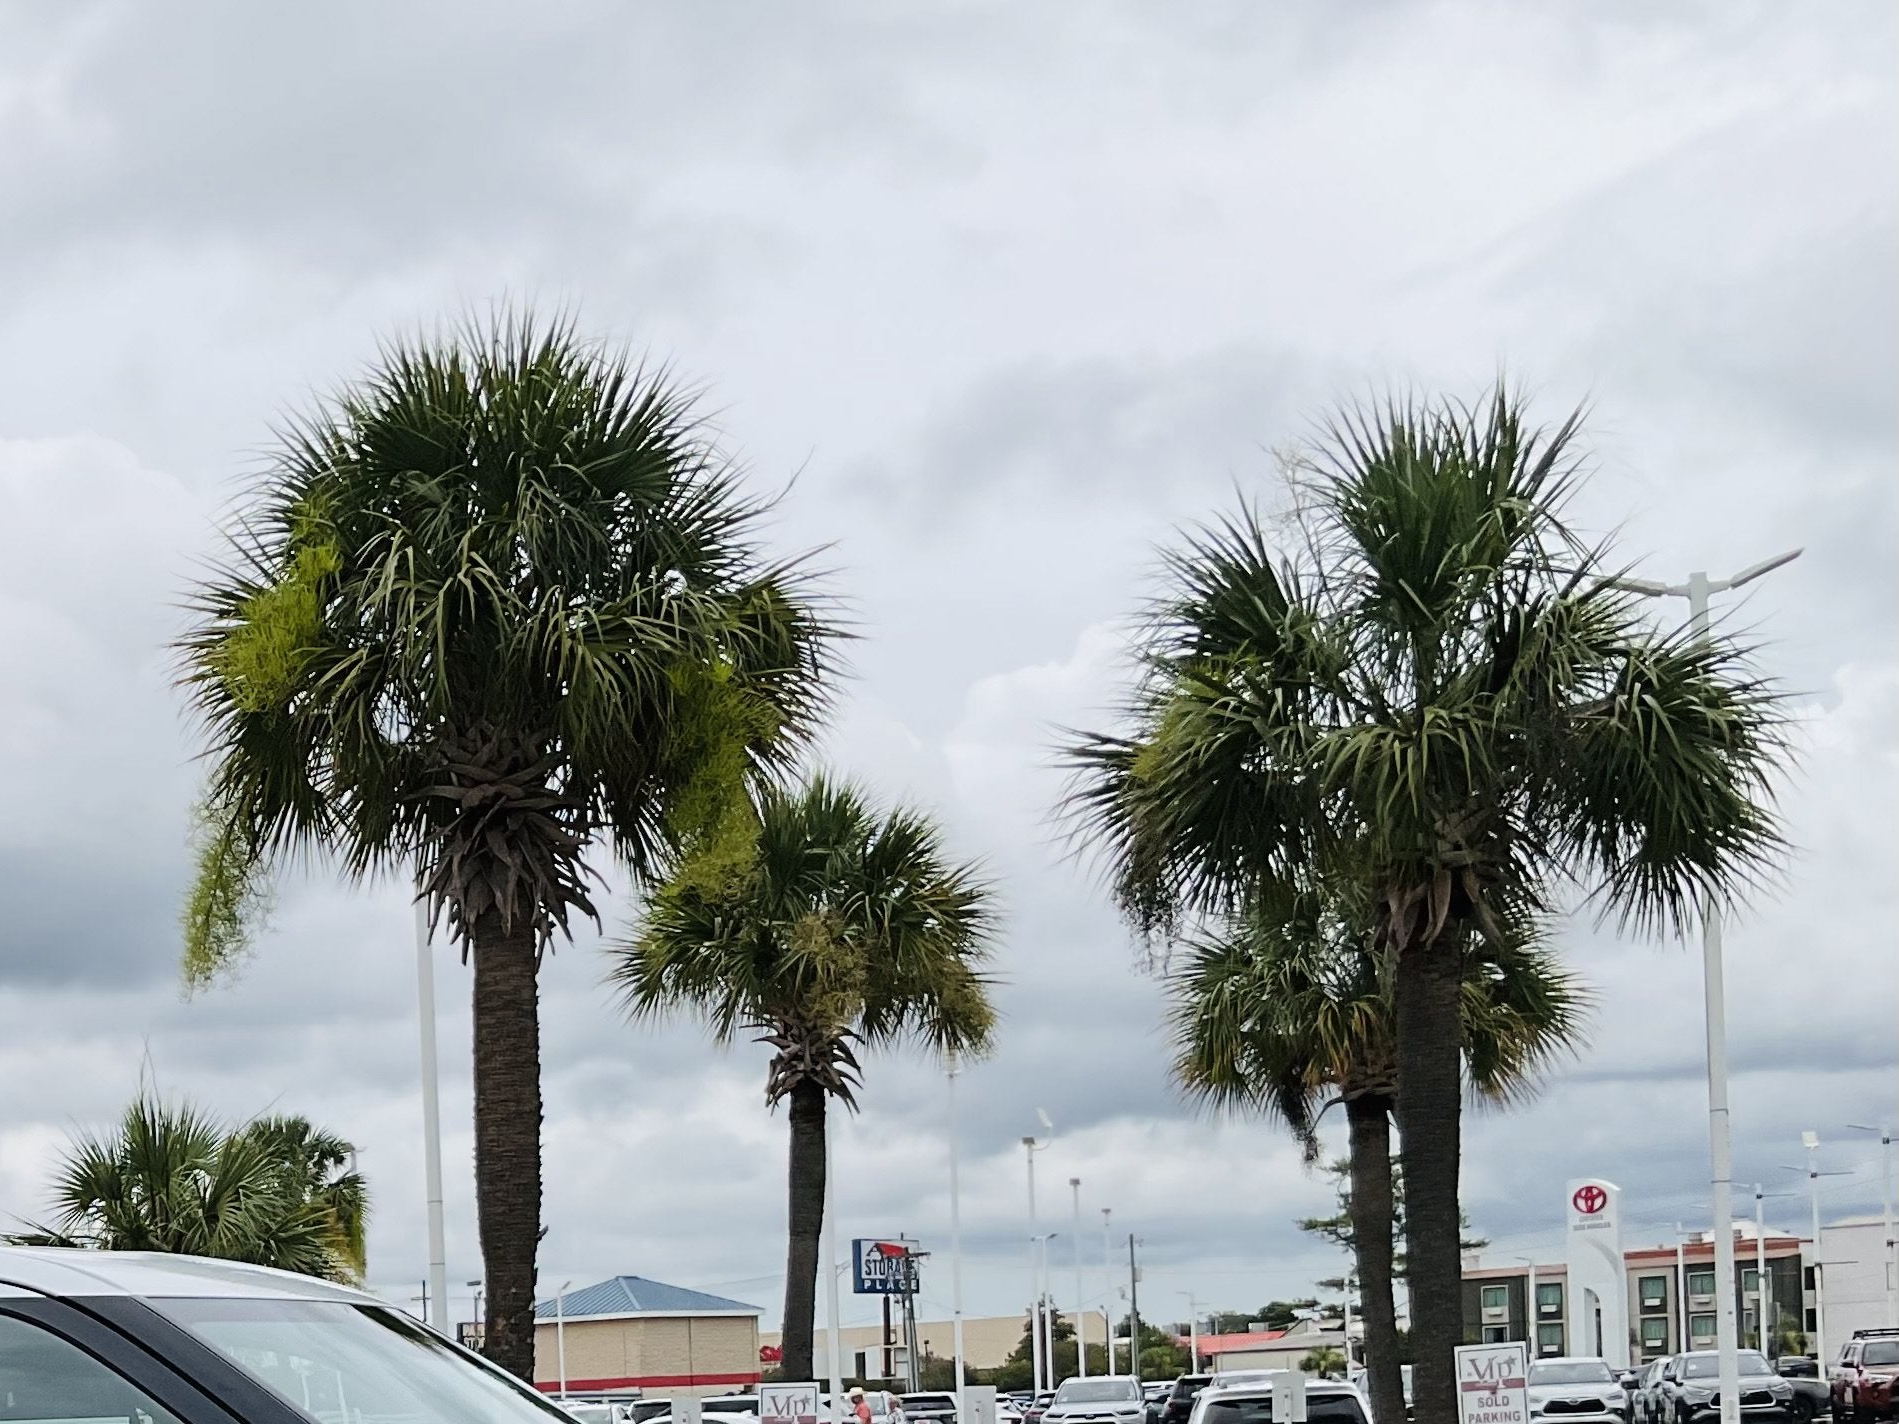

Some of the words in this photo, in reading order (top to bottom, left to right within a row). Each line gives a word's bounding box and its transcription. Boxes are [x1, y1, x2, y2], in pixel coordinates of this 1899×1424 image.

[864, 1280, 917, 1290] PLACE
[1477, 1395, 1510, 1408] SOLD
[1468, 1411, 1521, 1424] PARKING
